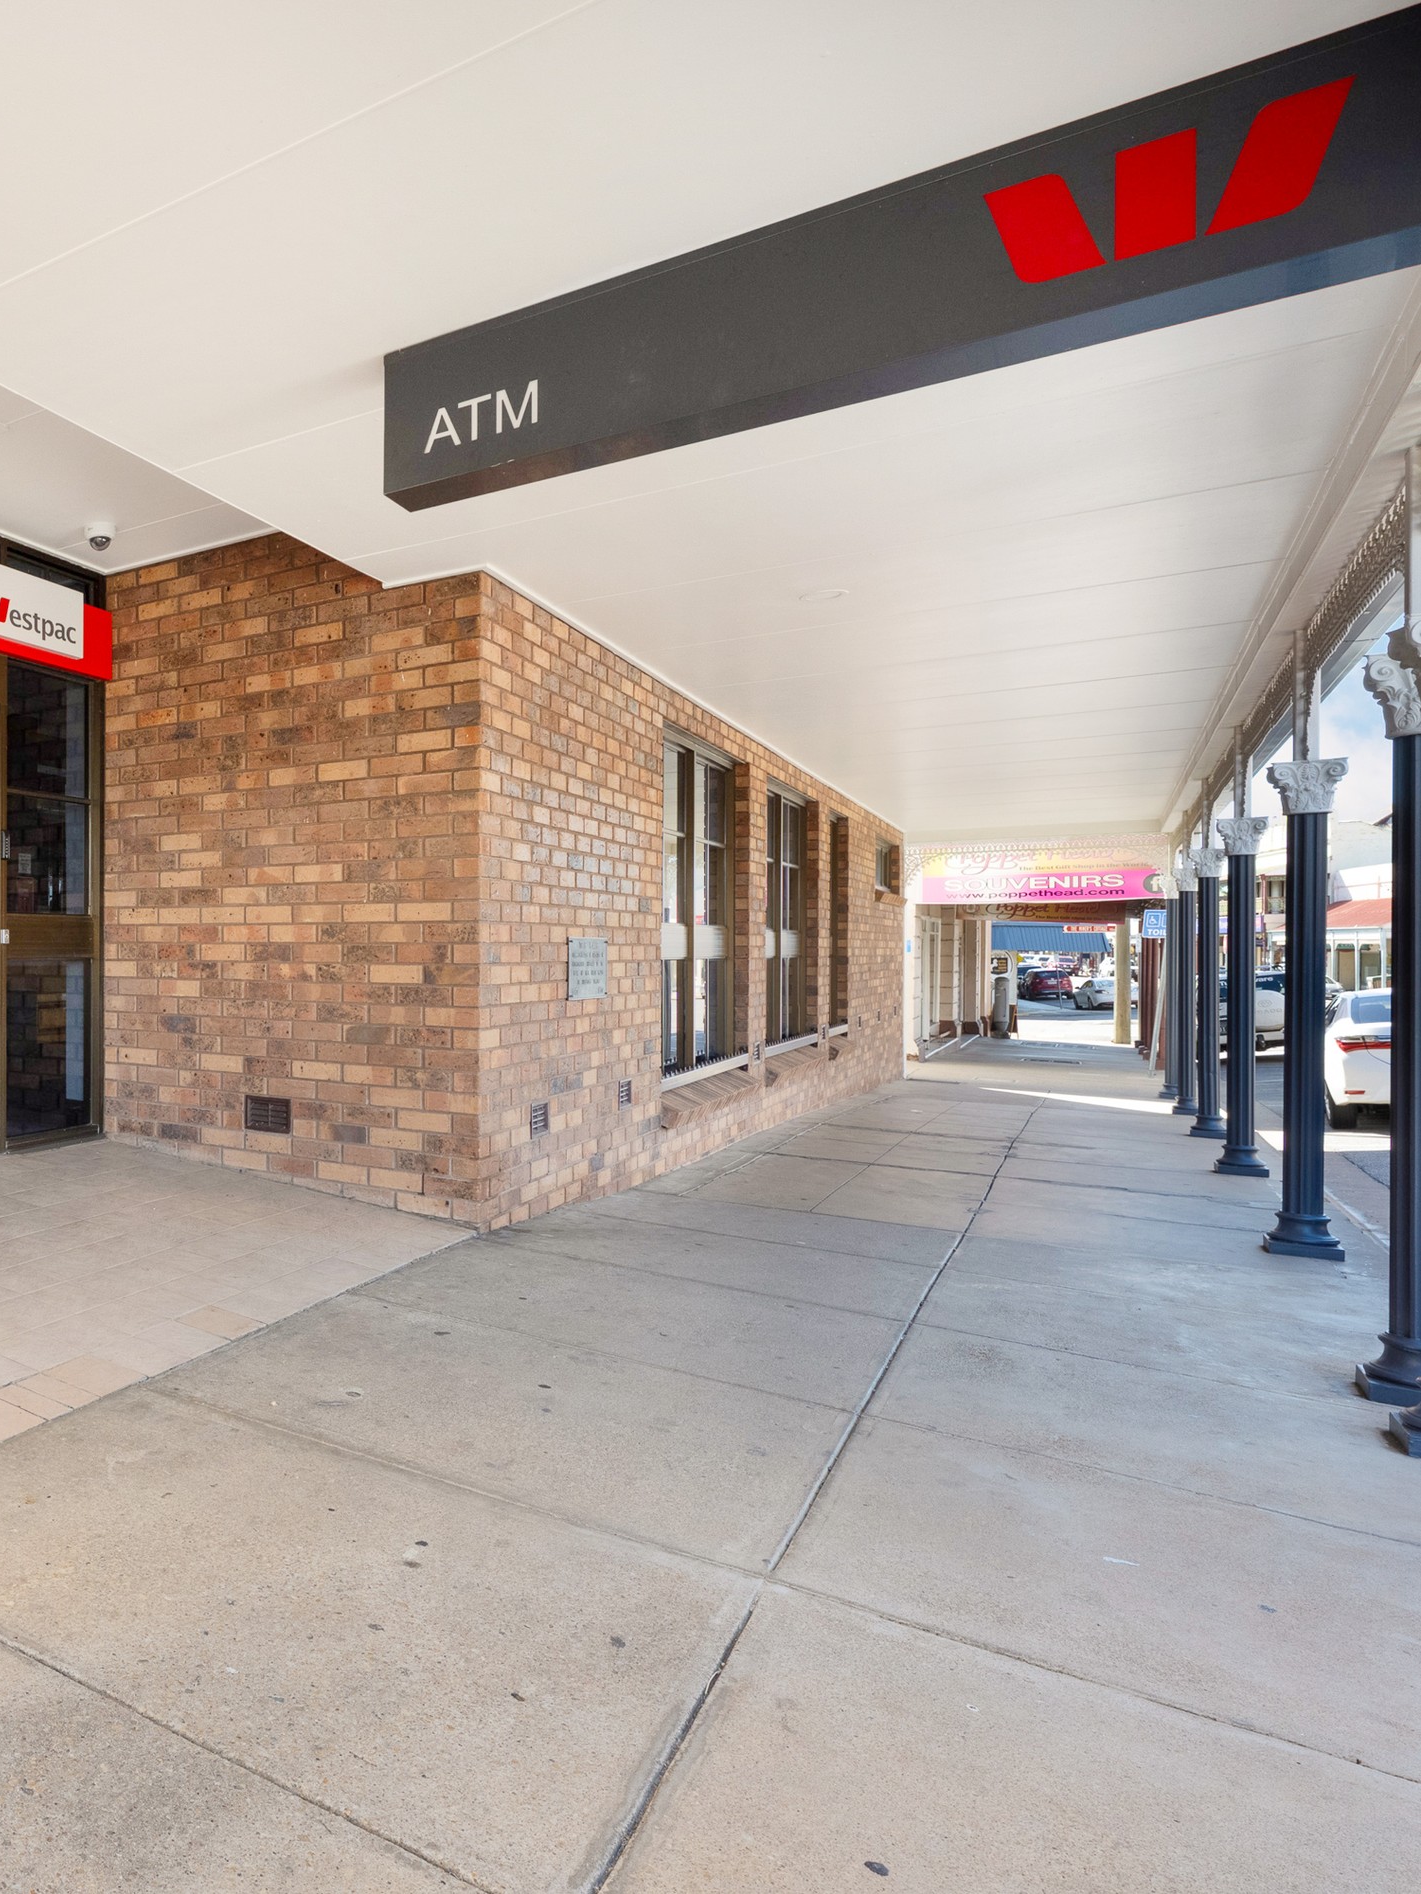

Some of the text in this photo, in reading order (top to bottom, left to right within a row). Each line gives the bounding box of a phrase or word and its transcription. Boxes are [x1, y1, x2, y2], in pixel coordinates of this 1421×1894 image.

[424, 379, 538, 454] ATM
[944, 874, 1125, 892] SOUVENIRS
[946, 888, 1125, 899] www.poppethead.com
